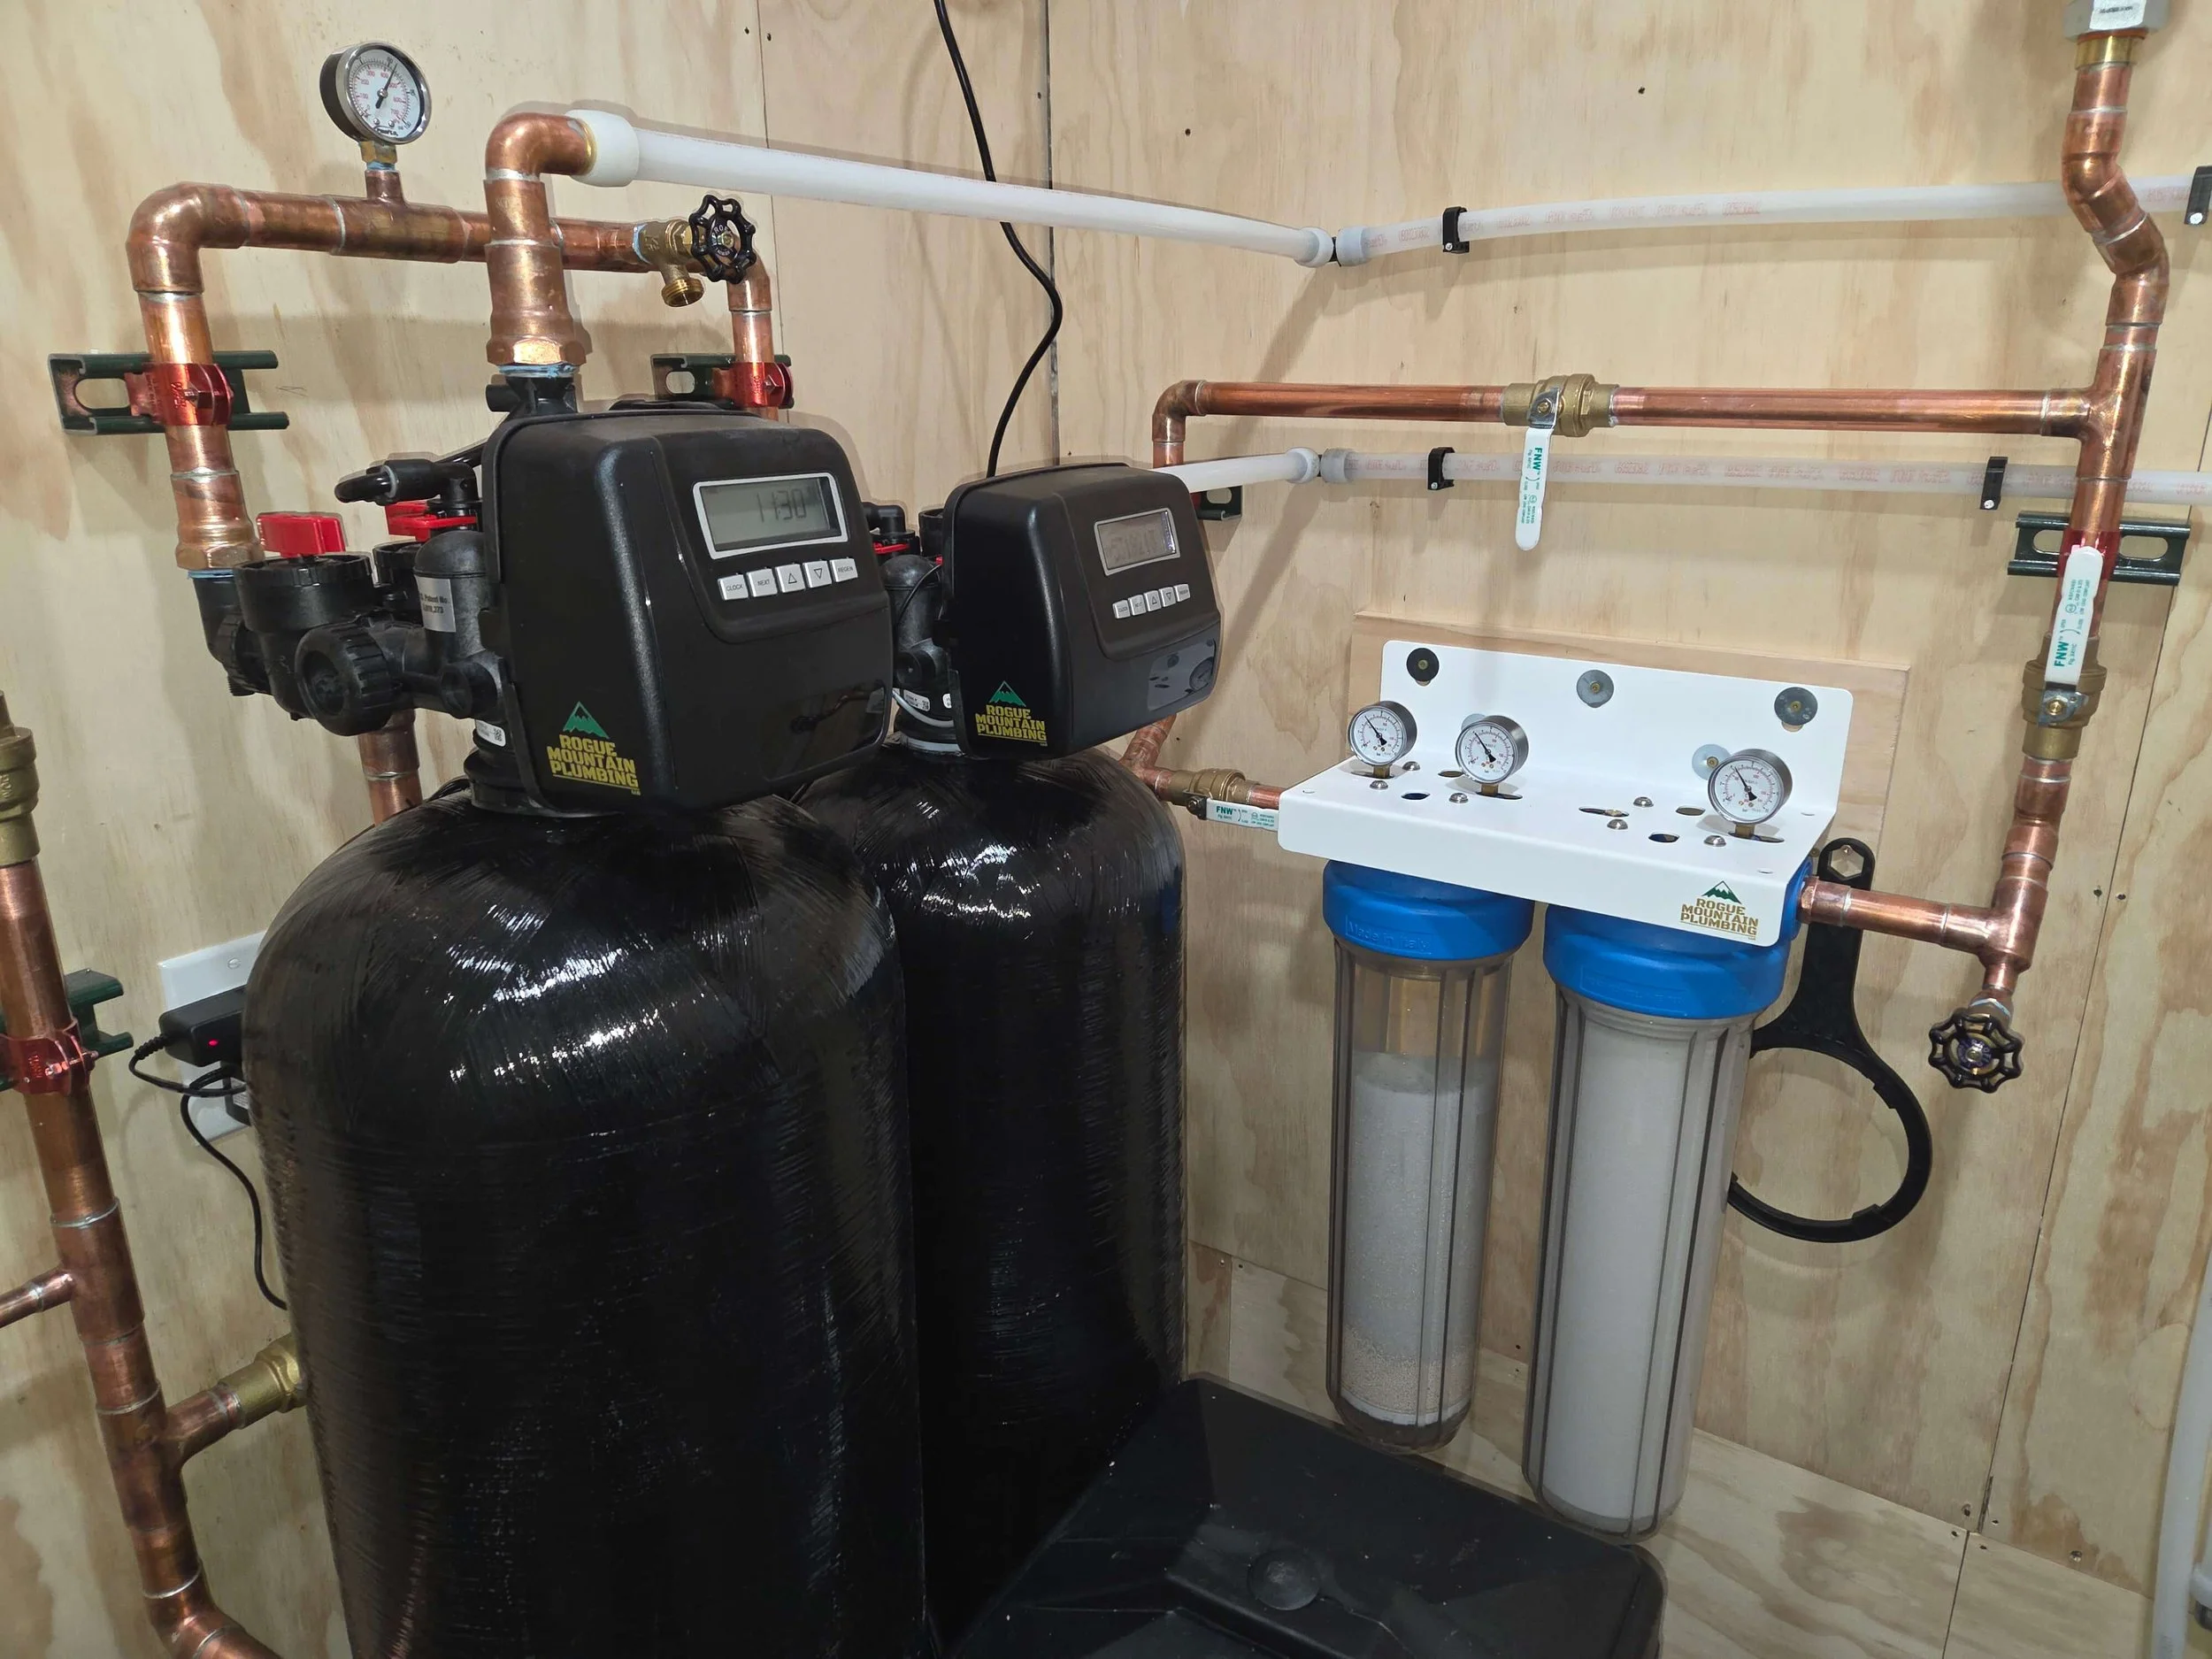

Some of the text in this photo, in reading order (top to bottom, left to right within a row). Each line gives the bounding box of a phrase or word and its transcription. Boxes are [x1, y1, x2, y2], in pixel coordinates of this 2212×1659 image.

[1532, 447, 1543, 471] FNW
[2054, 641, 2069, 667] FNW
[975, 712, 1046, 731] MOUNTAIN
[986, 704, 1032, 720] ROGUE
[976, 723, 1047, 741] PLUMBING
[558, 733, 618, 757] ROGUE
[546, 746, 636, 774] MOUNTAIN
[549, 760, 639, 787] PLUMBING
[1216, 805, 1233, 816] FNW
[1681, 903, 1759, 927] MOUNTAIN
[1696, 897, 1747, 916] ROGUE
[1680, 912, 1757, 936] PLUMBING
